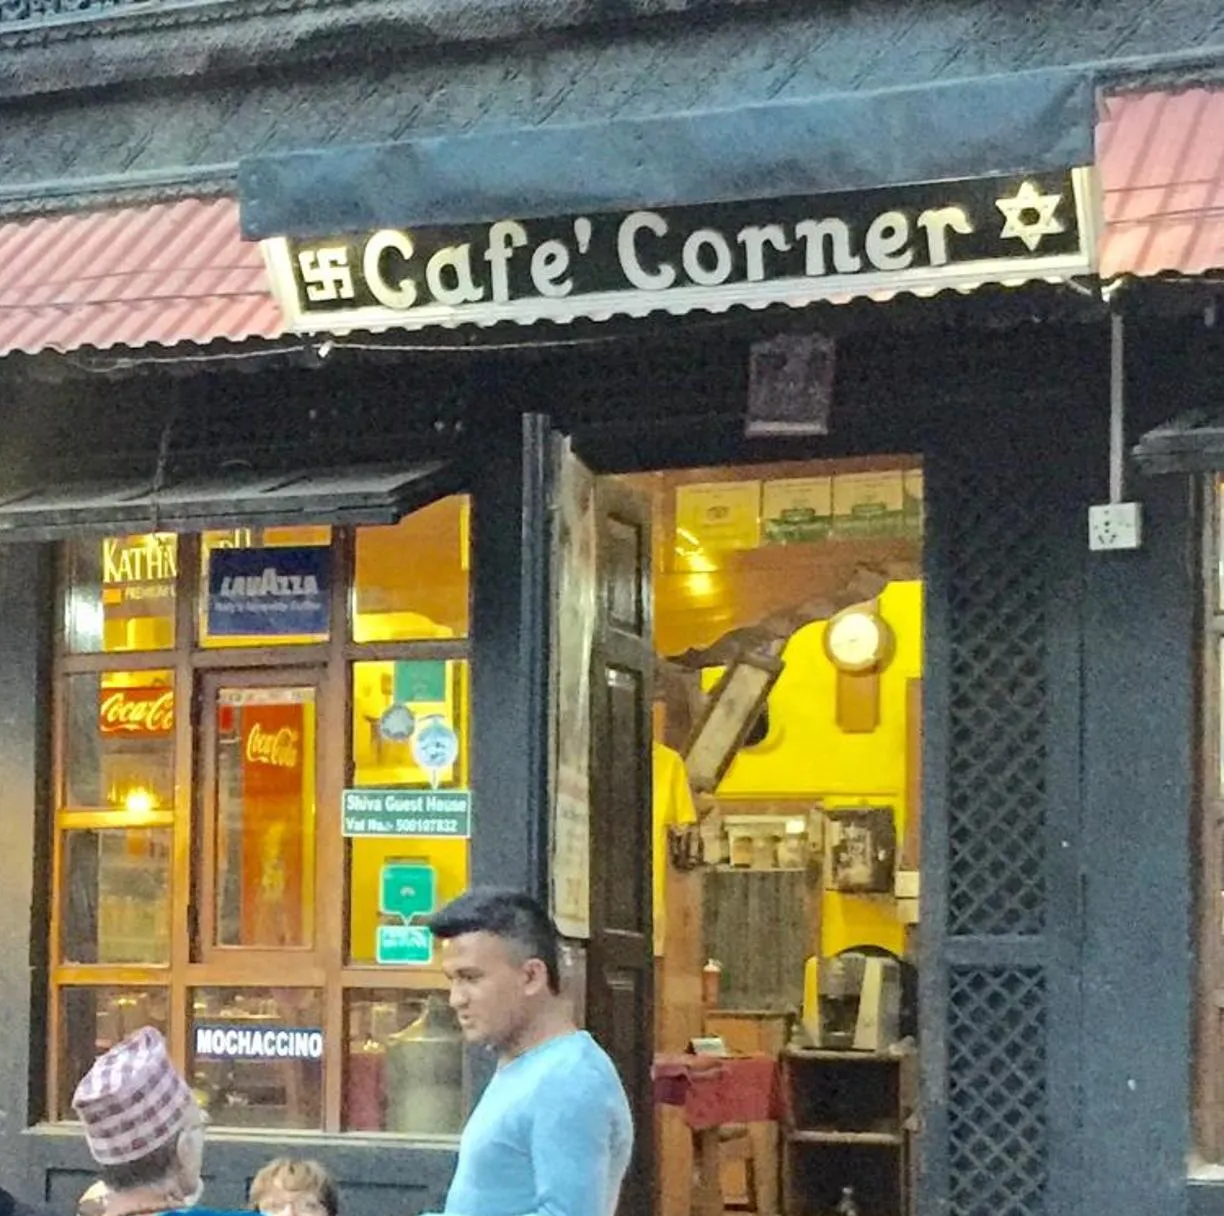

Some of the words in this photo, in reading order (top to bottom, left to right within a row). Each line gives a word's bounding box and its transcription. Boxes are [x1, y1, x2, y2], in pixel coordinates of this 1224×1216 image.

[616, 204, 974, 292] Corner
[220, 567, 319, 597] LAVAZZA
[347, 794, 382, 812] Shiva
[385, 795, 423, 812] Guest
[425, 796, 466, 812] House
[196, 1027, 323, 1057] MOCHACCINO
